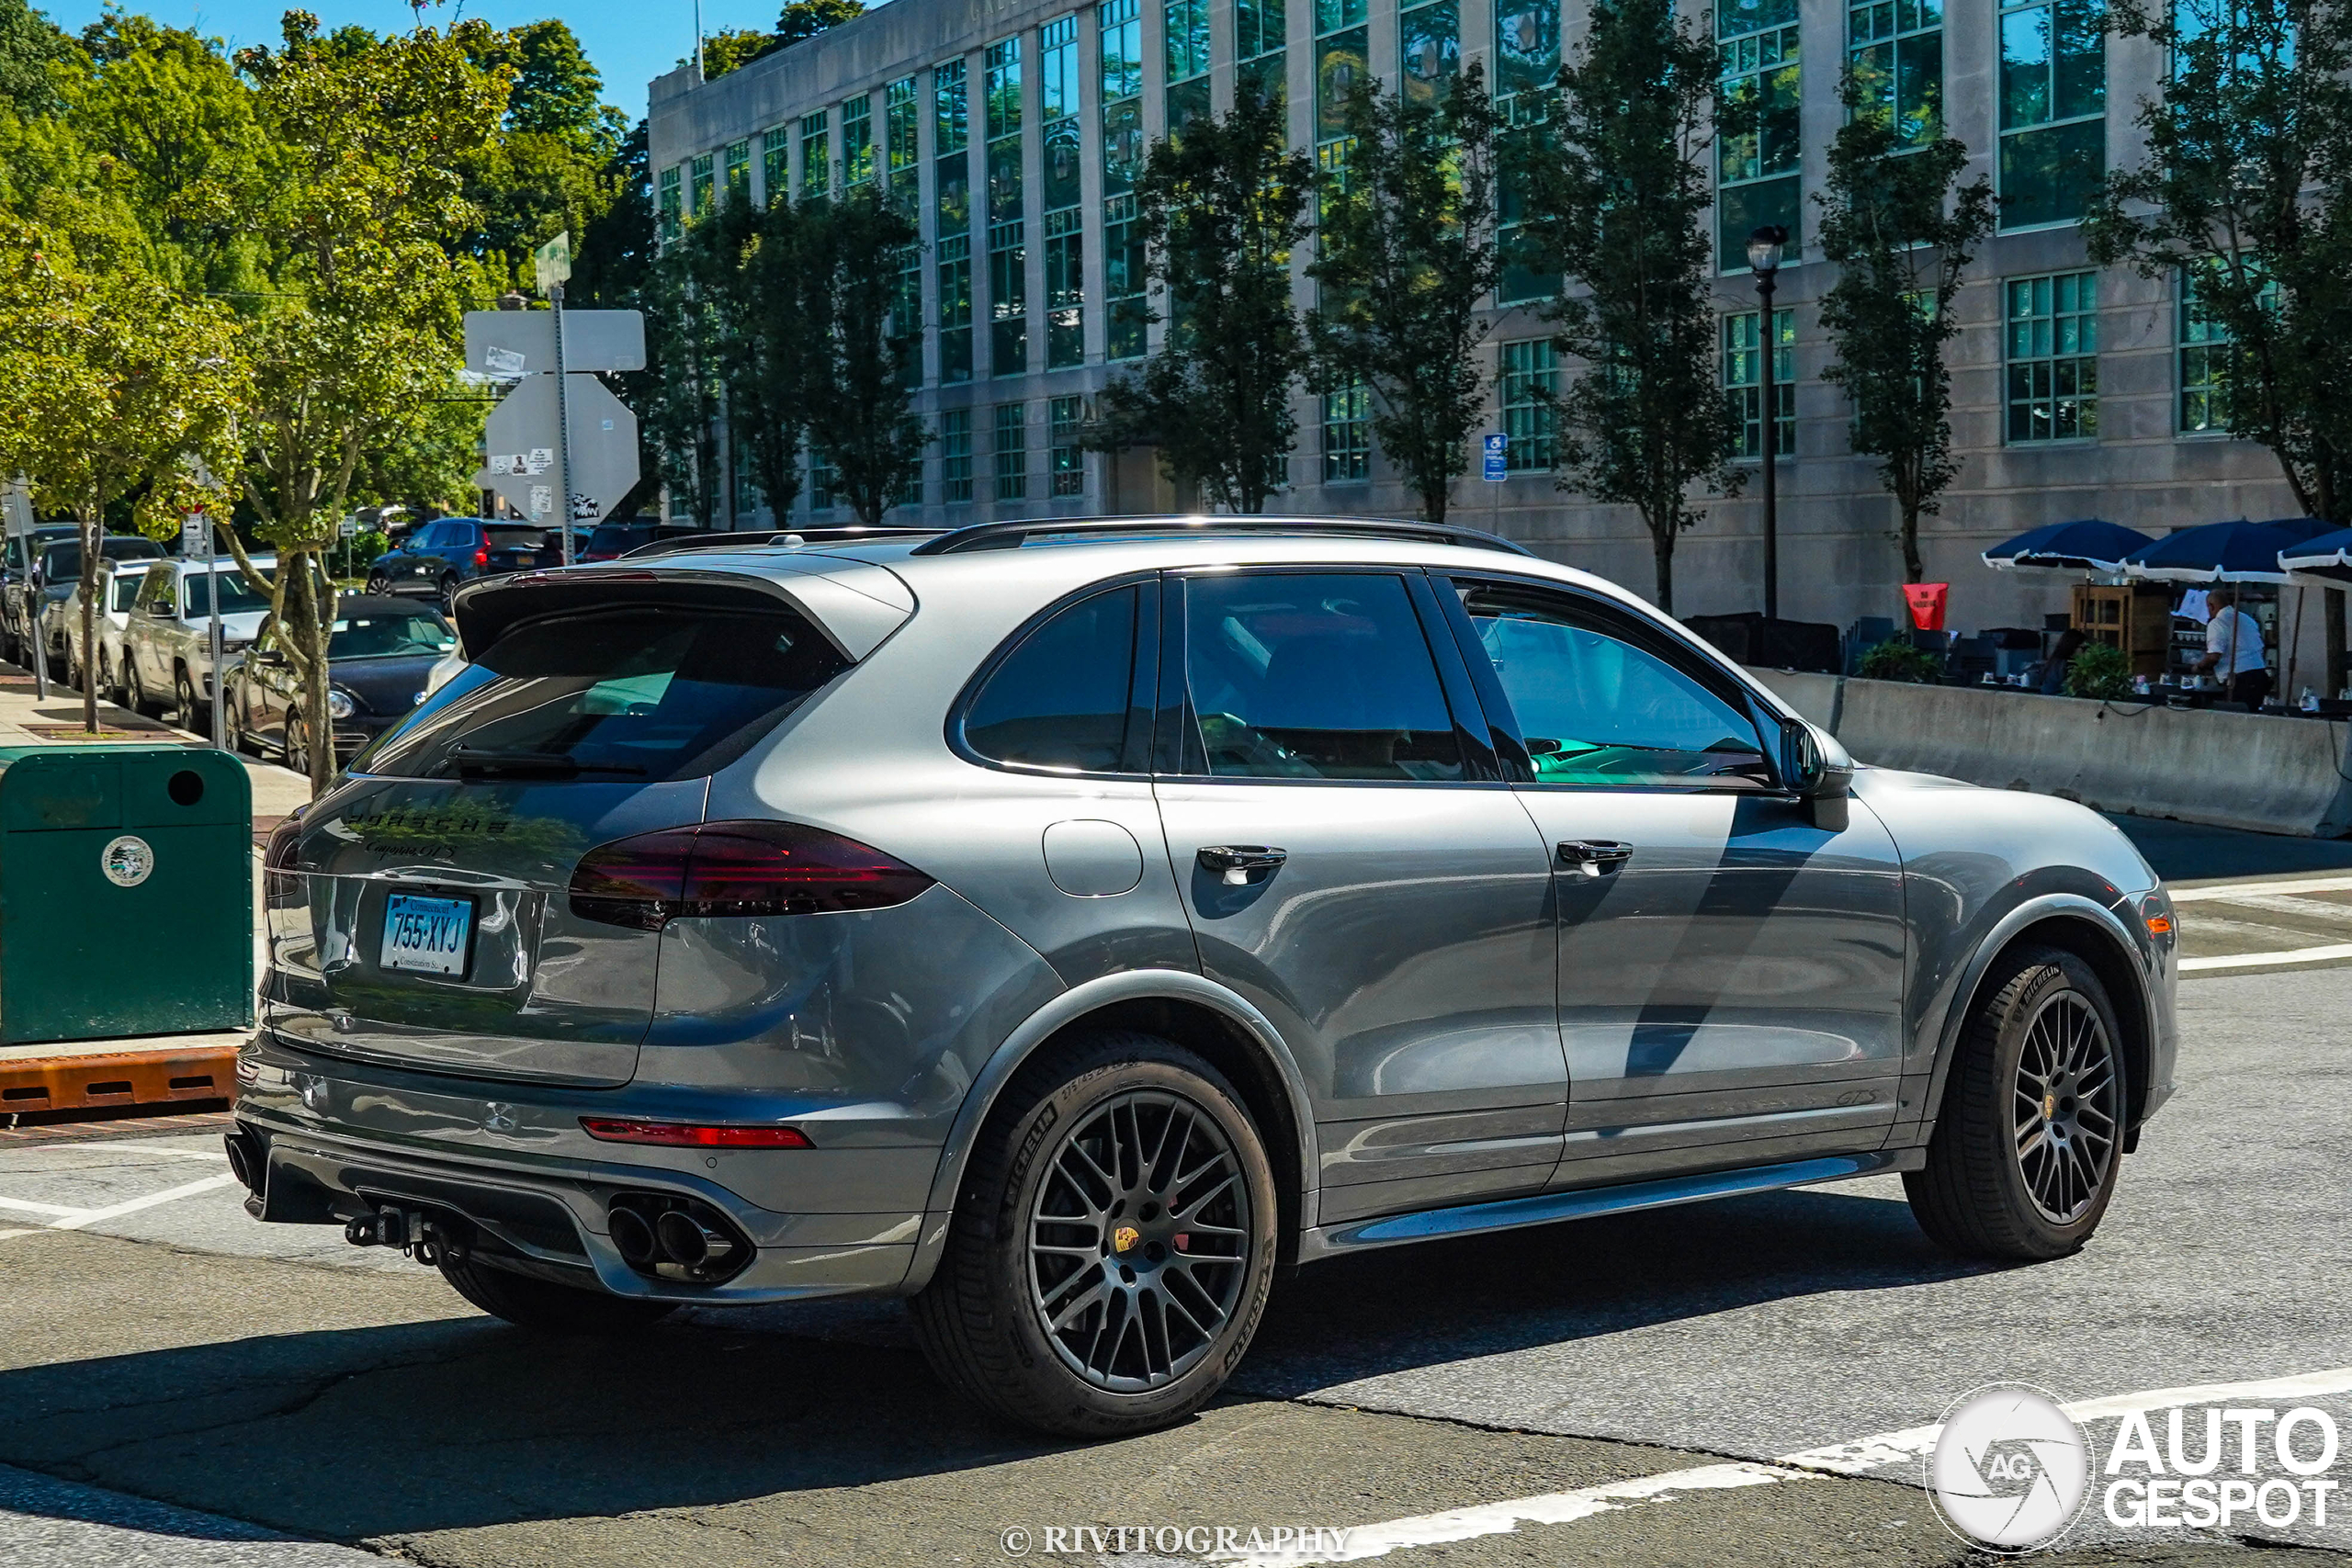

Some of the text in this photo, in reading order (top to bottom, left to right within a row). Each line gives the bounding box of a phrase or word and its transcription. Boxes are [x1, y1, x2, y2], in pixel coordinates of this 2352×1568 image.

[348, 814, 508, 833] PORSCHE
[410, 900, 450, 915] Connecticut
[2024, 965, 2060, 1005] MICHELIN
[1836, 1089, 1880, 1105] GTS
